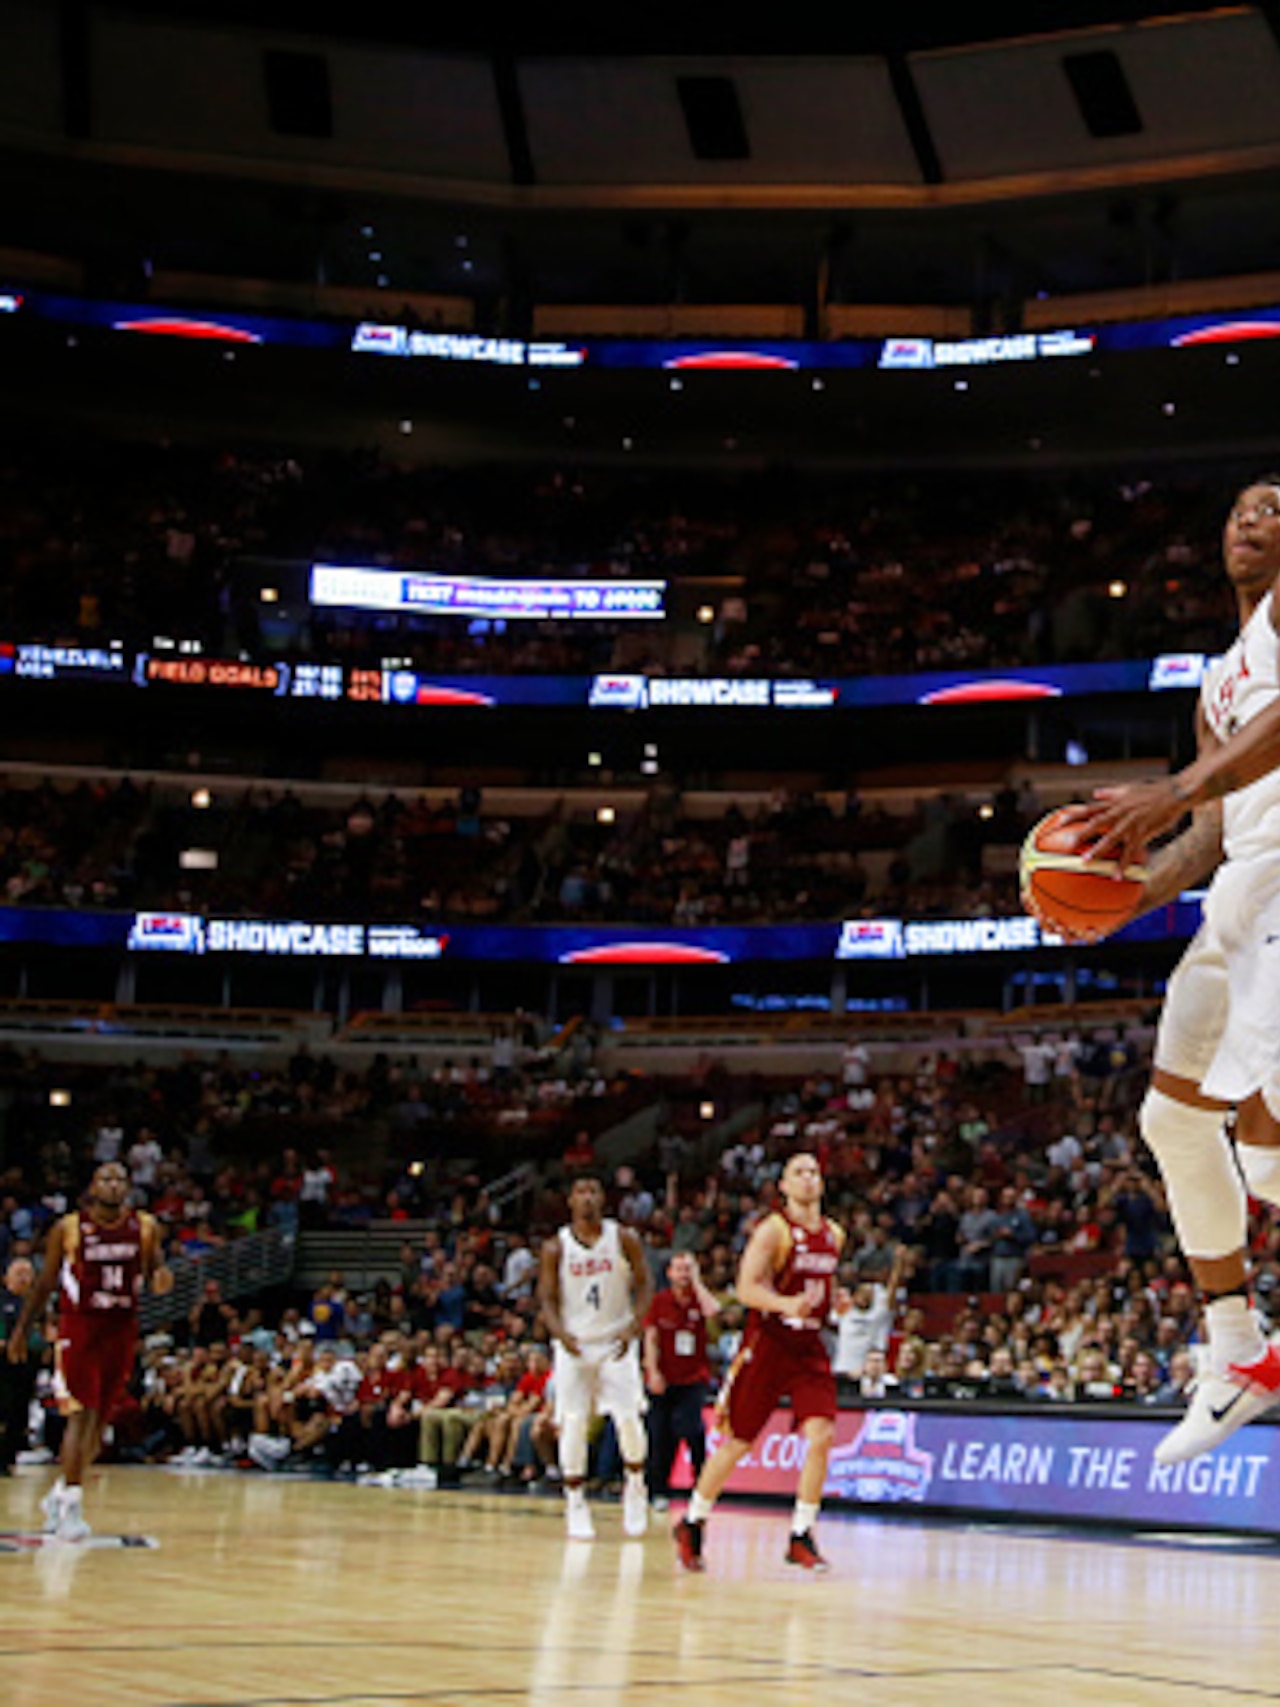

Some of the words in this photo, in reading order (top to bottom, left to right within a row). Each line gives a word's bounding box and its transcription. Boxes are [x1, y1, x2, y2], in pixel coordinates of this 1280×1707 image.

[409, 331, 525, 364] SHOWCASE
[934, 335, 1036, 365] SHOWCASE
[148, 660, 206, 684] FIELD
[209, 664, 278, 689] GOALS
[649, 679, 770, 705] SHOWCASE
[207, 920, 364, 955] SHOWCASE
[905, 917, 1040, 955] SHOWCASE
[570, 1258, 612, 1277] USA
[586, 1284, 600, 1311] 4
[940, 1441, 1055, 1486] LEARN
[1068, 1446, 1138, 1490] THE
[1147, 1454, 1270, 1498] RIGHT
